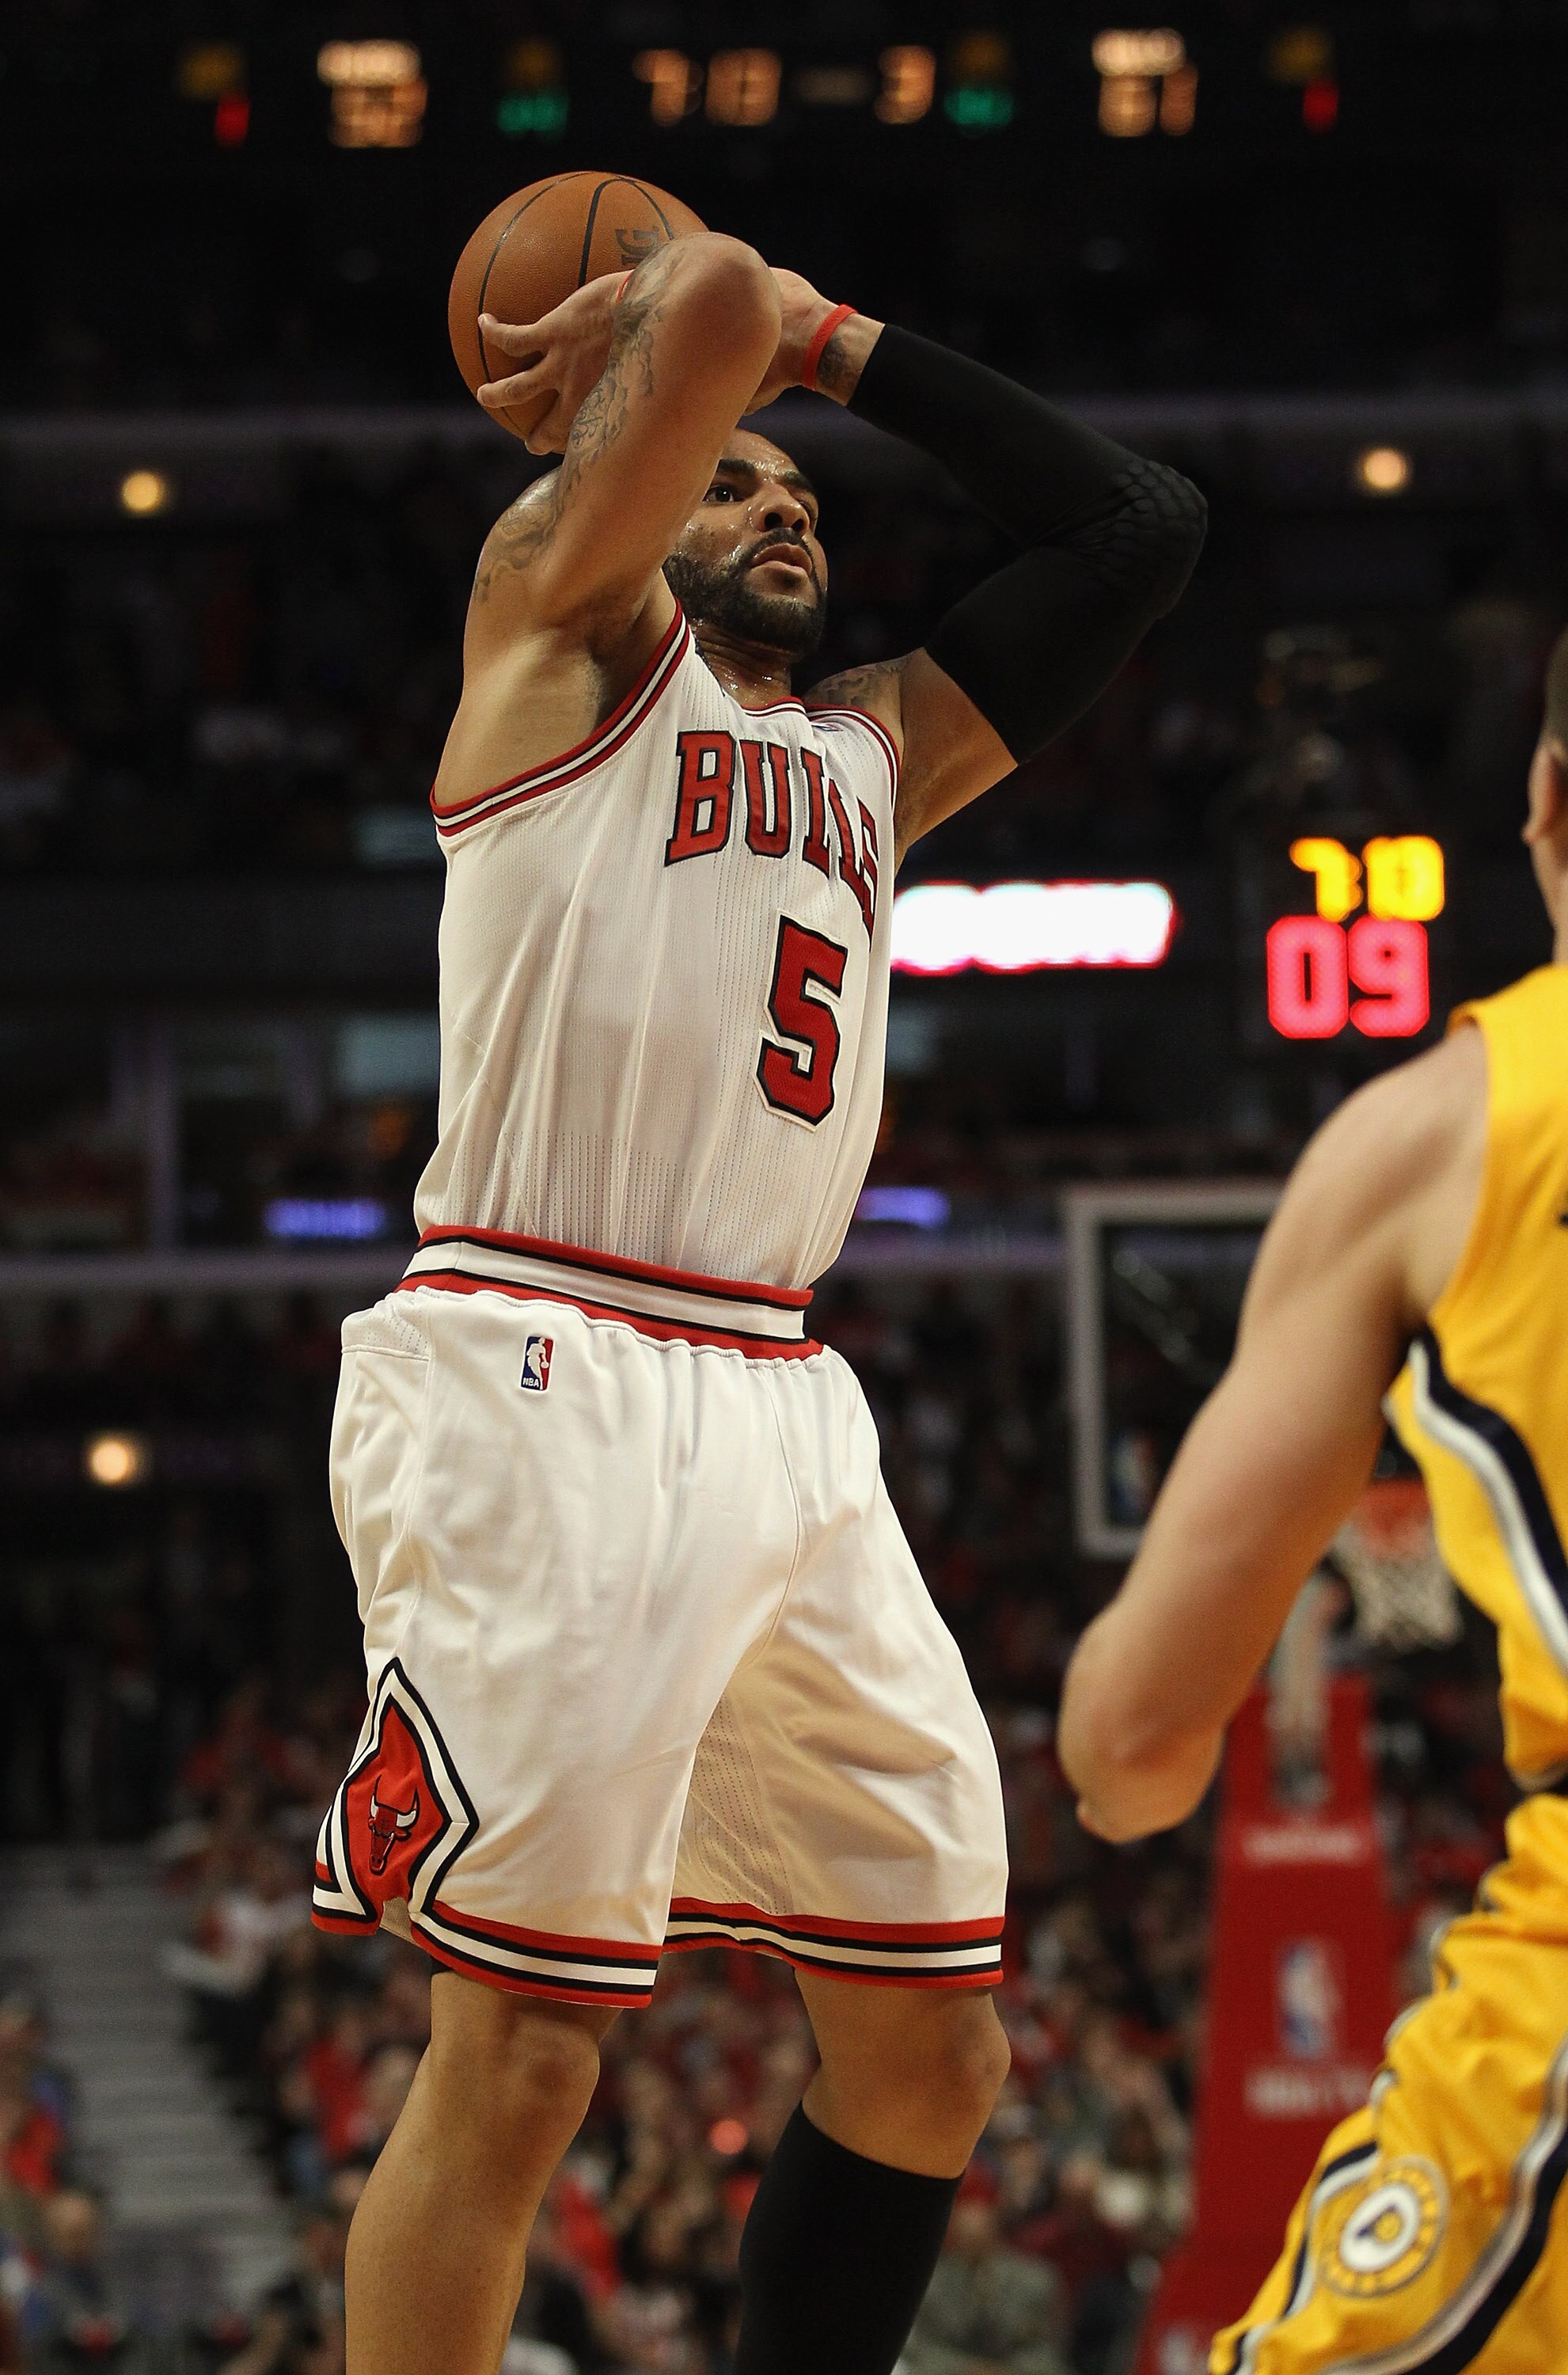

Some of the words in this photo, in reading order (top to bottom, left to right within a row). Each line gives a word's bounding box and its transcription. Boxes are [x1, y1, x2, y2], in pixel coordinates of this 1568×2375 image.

[664, 729, 878, 952] BULLS
[754, 909, 849, 1130] 5
[1266, 915, 1429, 1039] 09
[522, 1378, 539, 1387] NBA
